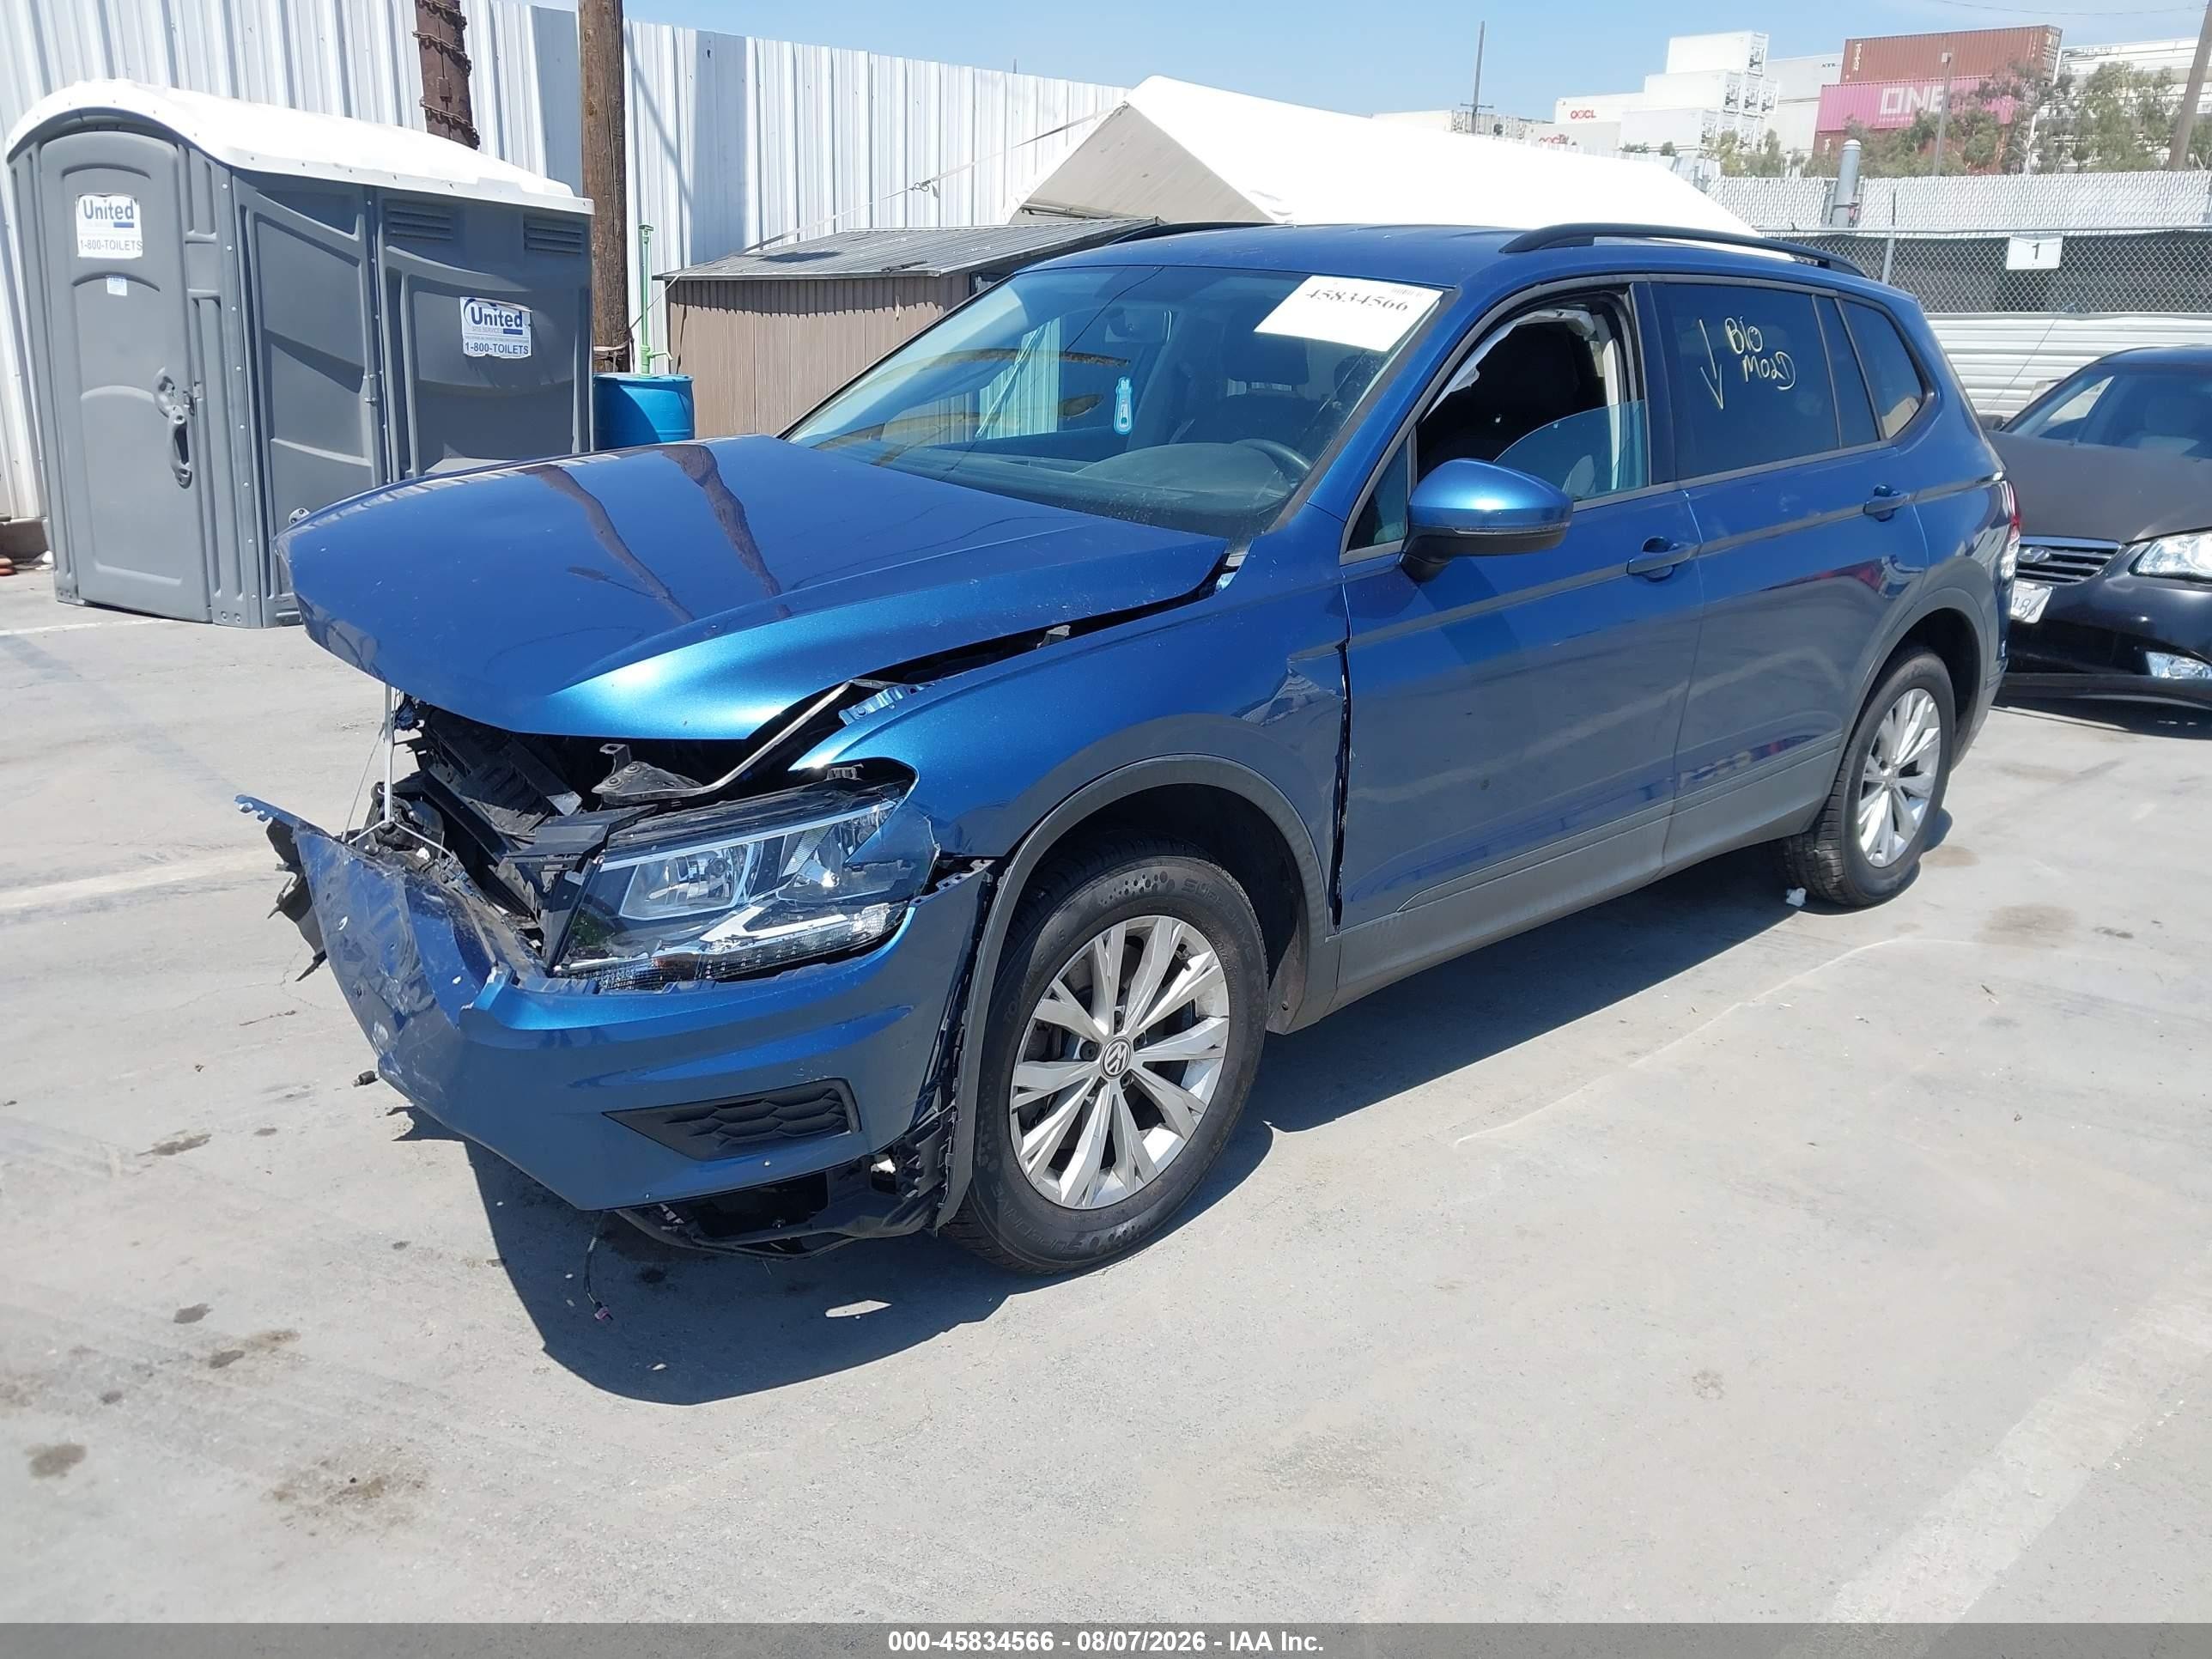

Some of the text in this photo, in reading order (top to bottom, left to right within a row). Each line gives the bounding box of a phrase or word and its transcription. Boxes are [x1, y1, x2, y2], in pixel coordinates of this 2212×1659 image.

[1571, 109, 1596, 119] OOCL
[83, 198, 134, 220] United
[81, 240, 143, 252] 1-800-TOILETS
[2032, 242, 2040, 259] 1
[471, 307, 523, 327] United
[465, 342, 529, 355] 1-800-TOILETS
